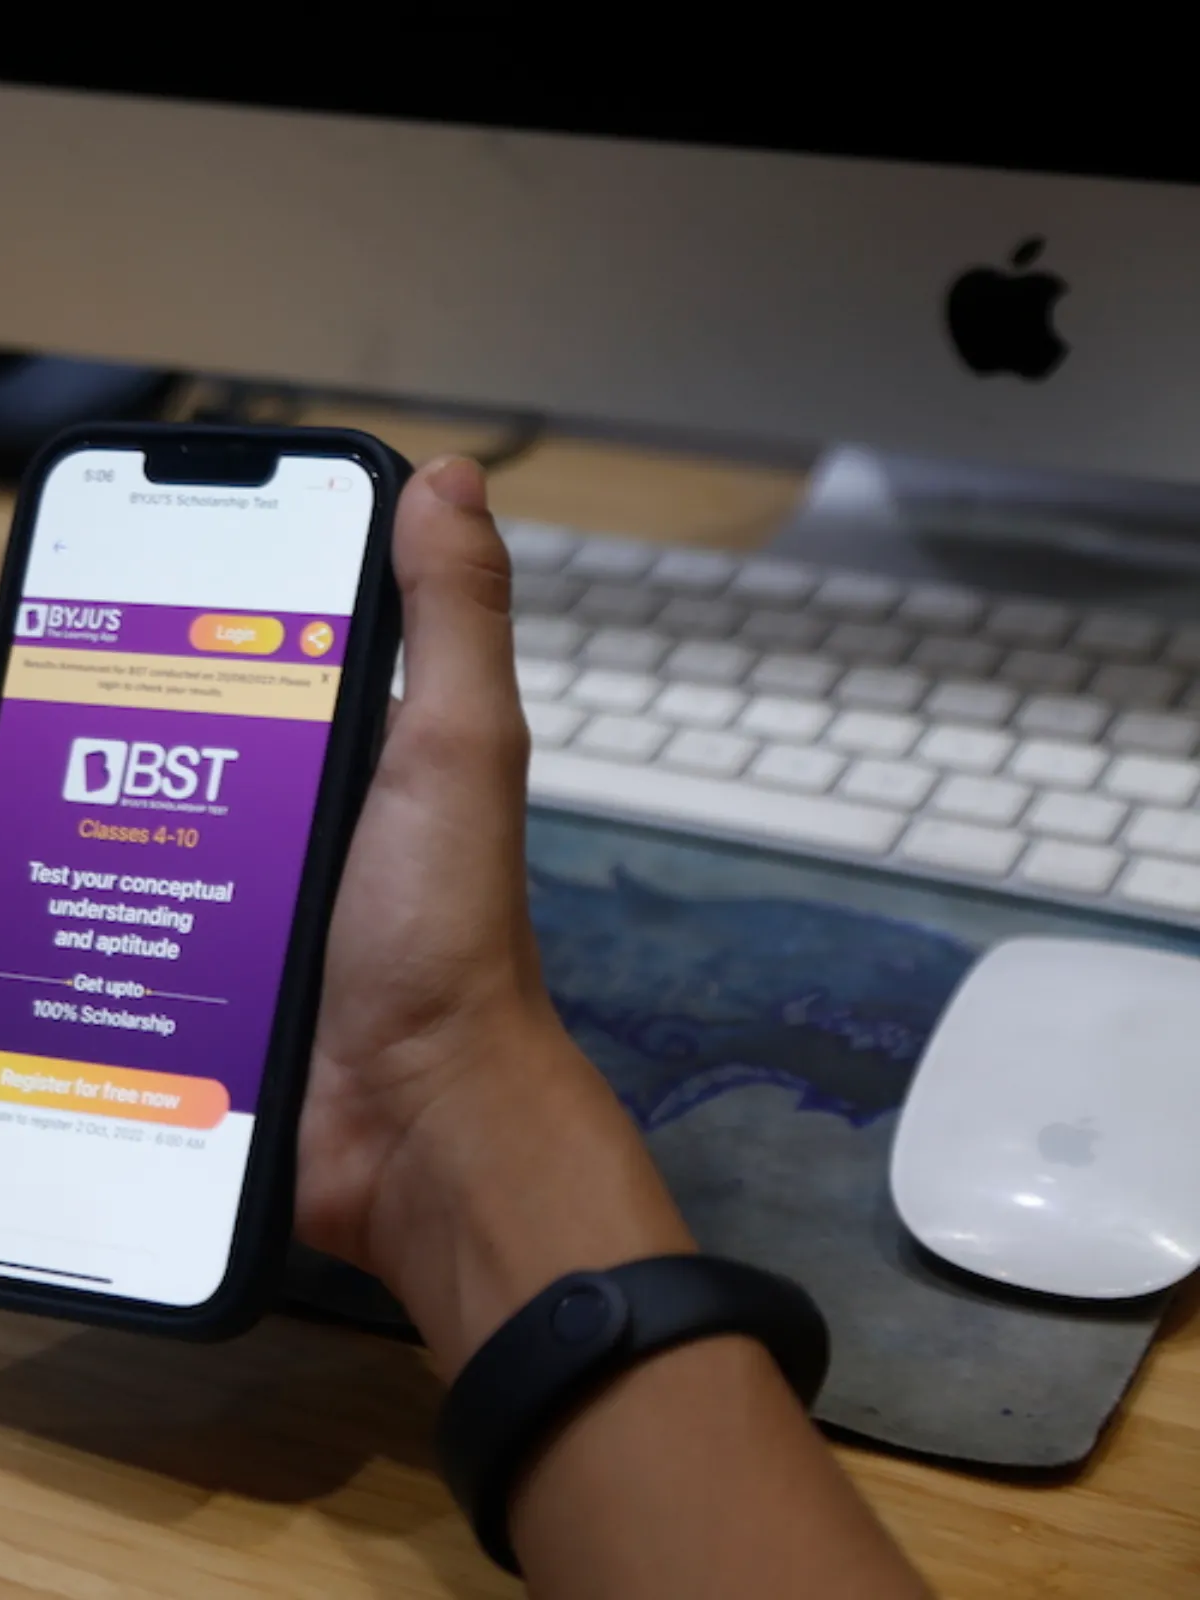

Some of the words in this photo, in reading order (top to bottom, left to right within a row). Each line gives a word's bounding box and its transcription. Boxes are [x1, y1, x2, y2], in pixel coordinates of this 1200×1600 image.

[176, 495, 250, 510] Scholarship
[253, 497, 279, 509] Test
[47, 605, 122, 632] BYJU'S
[215, 625, 256, 645] Login
[123, 743, 239, 802] BST
[78, 818, 150, 845] Classes
[153, 825, 200, 849] 4-10
[29, 861, 70, 885] Test
[71, 870, 118, 891] your
[119, 876, 234, 902] conceptual
[48, 898, 194, 933] understanding
[54, 930, 94, 949] and
[95, 934, 181, 960] aptitude
[73, 973, 104, 993] Get
[105, 977, 145, 998] upto
[32, 999, 78, 1023] 100%
[80, 1004, 177, 1037] Scholarship
[0, 1067, 72, 1095] Register
[74, 1077, 102, 1099] for
[102, 1081, 141, 1104] free
[140, 1090, 181, 1110] now
[16, 1113, 28, 1125] to
[30, 1117, 73, 1131] register
[74, 1119, 84, 1133] 2
